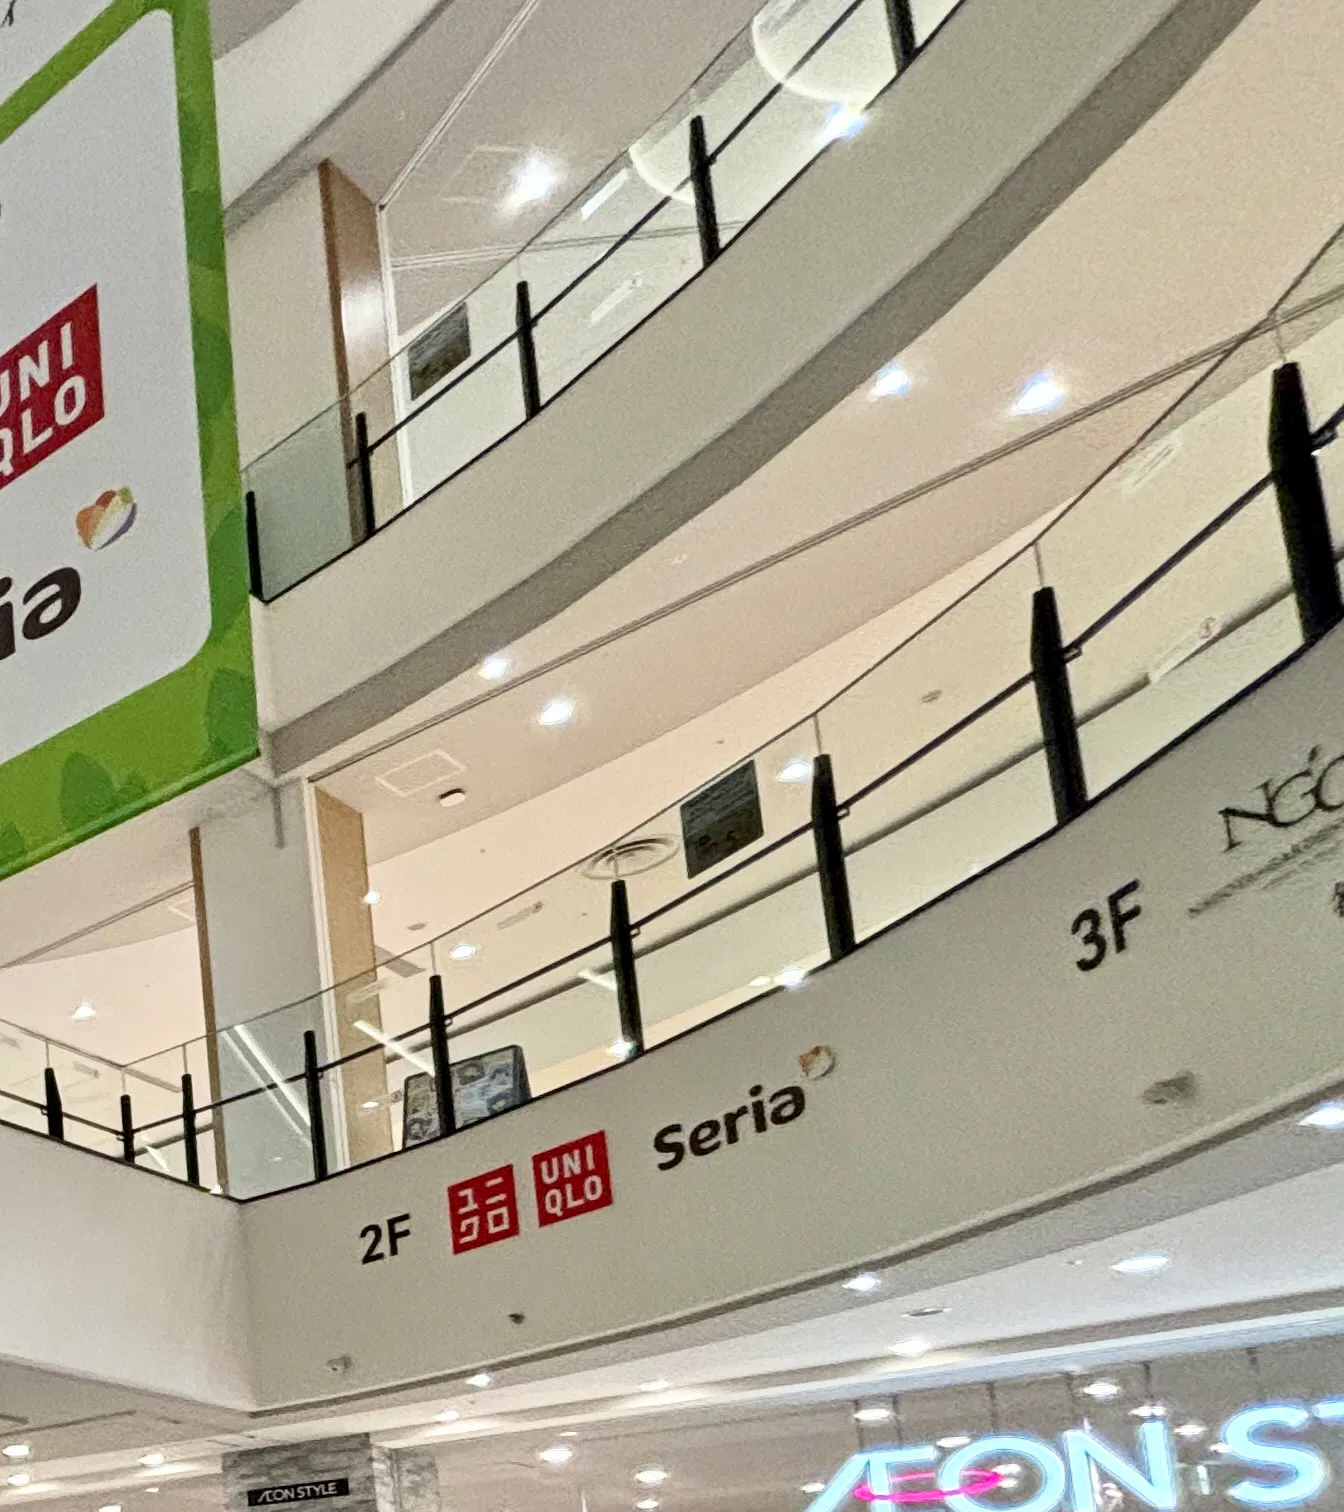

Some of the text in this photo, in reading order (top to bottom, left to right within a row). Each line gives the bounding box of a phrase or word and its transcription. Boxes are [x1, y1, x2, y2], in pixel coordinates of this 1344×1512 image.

[1071, 879, 1142, 972] 3F
[653, 1084, 806, 1171] Seria
[541, 1144, 596, 1187] UNI
[544, 1173, 604, 1217] QLO
[359, 1213, 411, 1265] 2F
[1220, 1398, 1344, 1508] S
[296, 1482, 338, 1499] STYLE
